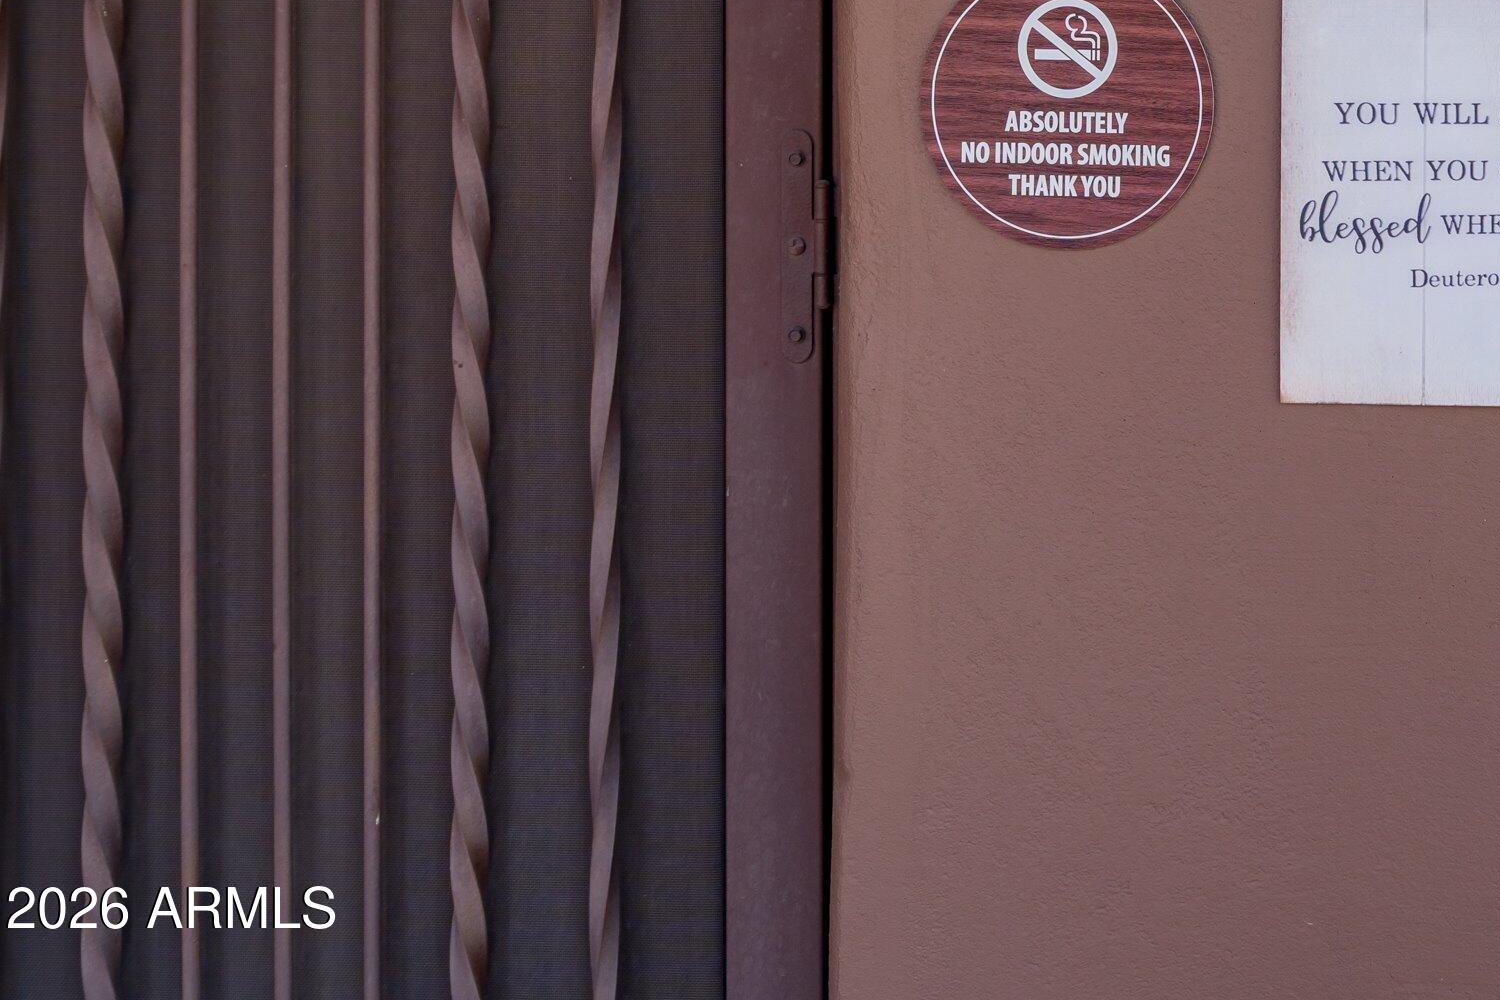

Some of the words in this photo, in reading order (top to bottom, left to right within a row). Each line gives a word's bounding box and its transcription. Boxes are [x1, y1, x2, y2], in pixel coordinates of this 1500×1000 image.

[1004, 110, 1129, 135] ABSOLUTELY
[1333, 101, 1400, 126] YOU
[1413, 101, 1490, 126] WILL
[960, 141, 990, 164] NO
[994, 141, 1073, 166] INDOOR
[1077, 143, 1171, 167] SMOKING
[1321, 159, 1413, 183] WHEN
[1425, 159, 1489, 182] YOU
[1008, 174, 1078, 198] THANK
[1080, 175, 1122, 198] YOU
[1298, 189, 1432, 255] blessed
